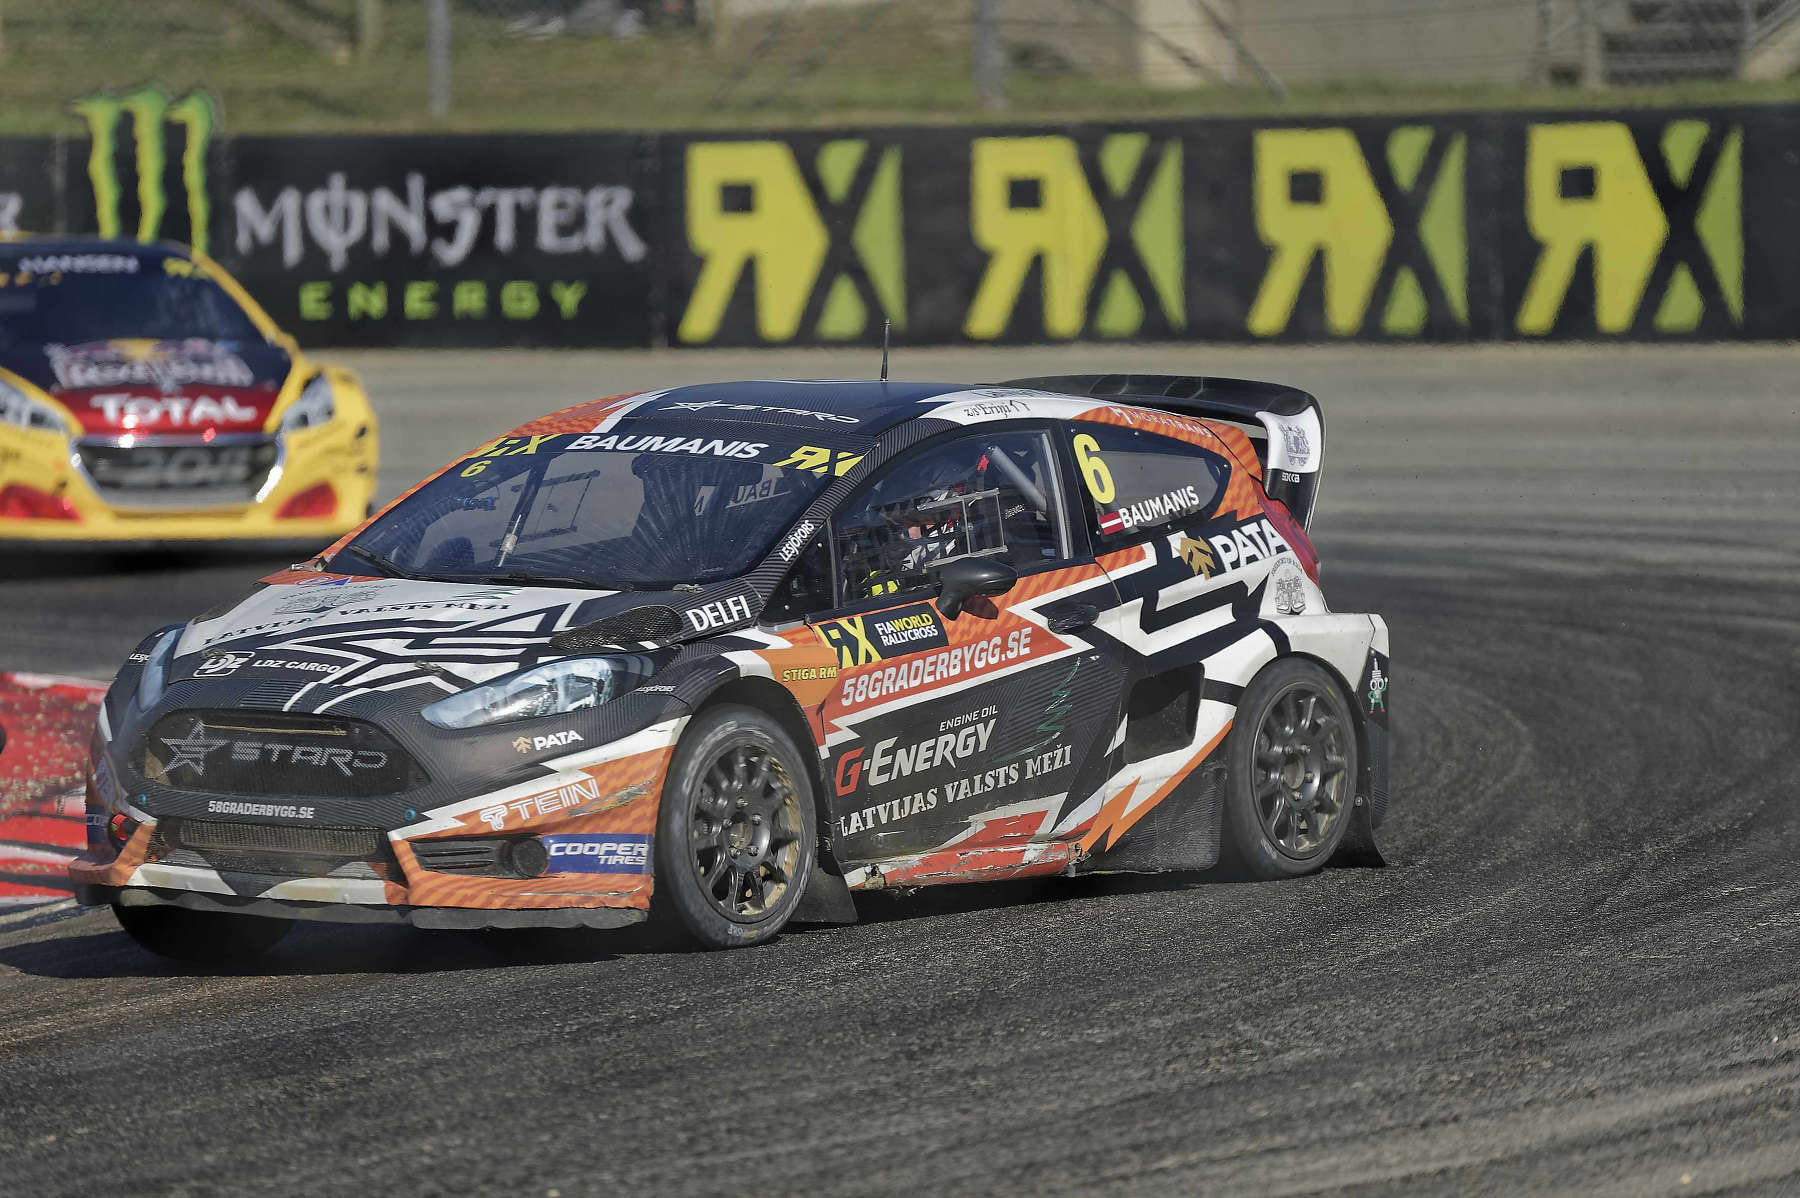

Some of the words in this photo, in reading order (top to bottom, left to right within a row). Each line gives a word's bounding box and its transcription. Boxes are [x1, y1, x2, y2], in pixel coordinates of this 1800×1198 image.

[234, 172, 646, 272] MONSTER
[300, 281, 586, 320] ENERGY
[91, 393, 257, 426] TOTAL
[727, 404, 860, 424] STARD
[565, 435, 770, 459] BAUMANIS
[461, 460, 492, 478] 6
[1073, 433, 1116, 504] 6
[1119, 485, 1200, 529] BAUMANIS
[779, 519, 815, 562] LESJÖFORS
[1209, 518, 1291, 573] PATA
[685, 595, 751, 632] DELFI
[880, 625, 938, 647] RALLYCROSS
[253, 659, 284, 668] LDZ
[285, 660, 342, 674] CARGO
[782, 668, 818, 682] STIGA
[819, 666, 837, 679] RM
[841, 627, 1033, 706] 58GRADERBYGG.SE
[939, 709, 979, 732] ENGINE
[981, 704, 998, 719] OIL
[533, 730, 584, 750] PATA
[231, 741, 388, 776] STARD
[509, 778, 600, 821] TEIN
[840, 788, 938, 837] LATVIJAS
[945, 763, 1019, 803] VALSTS
[1025, 744, 1073, 779] MEŽI
[208, 800, 315, 819] 58GRADERBYGG.SE
[549, 842, 649, 856] COOPER
[598, 855, 647, 865] TIRES
